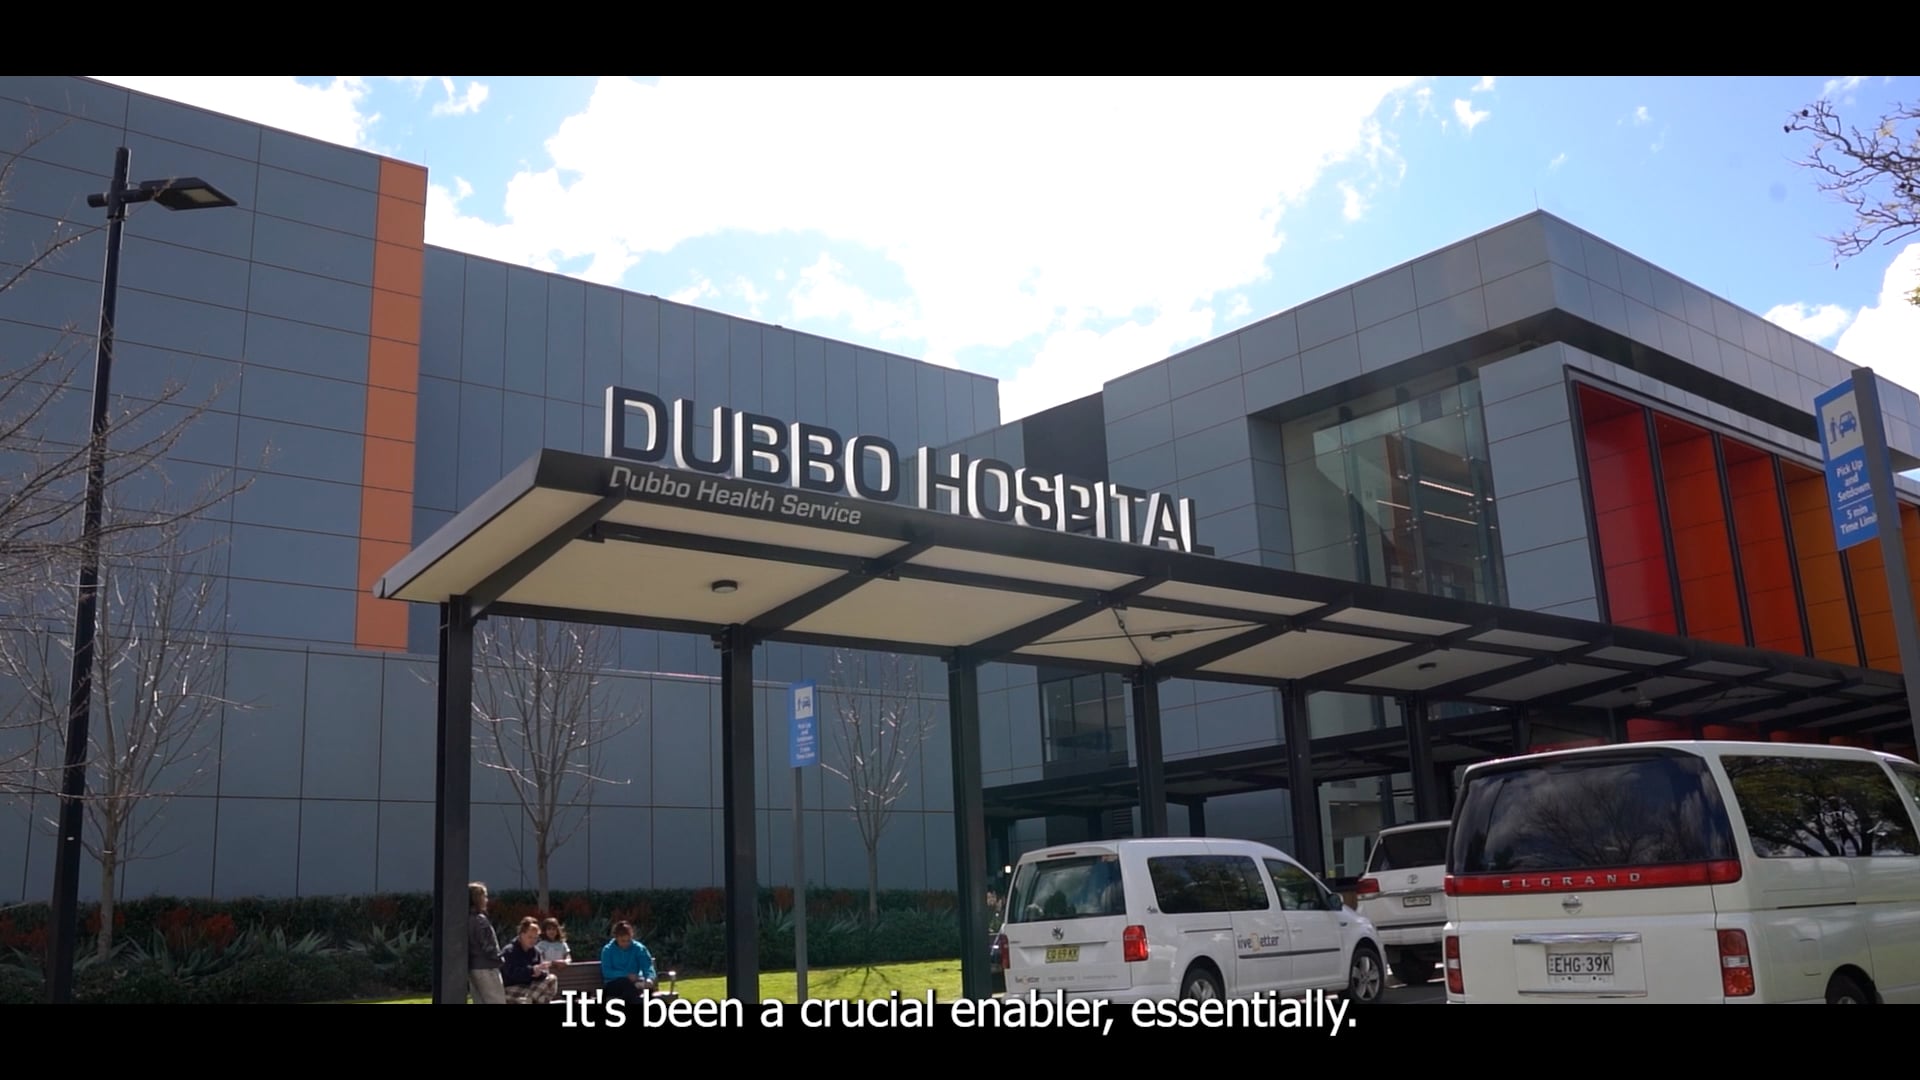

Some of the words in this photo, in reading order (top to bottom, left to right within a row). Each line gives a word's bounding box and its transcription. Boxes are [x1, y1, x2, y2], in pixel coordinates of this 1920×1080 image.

[605, 385, 900, 500] DUBBO
[918, 446, 1215, 557] HOSPITAL
[1836, 464, 1851, 478] Pick
[1844, 472, 1859, 487] and
[609, 465, 691, 500] Dubbo
[696, 480, 775, 515] Health
[780, 494, 862, 526] Service
[1846, 509, 1853, 520] 5
[1853, 505, 1868, 517] min
[1840, 522, 1859, 535] Time
[1502, 873, 1640, 888] ELGRAND
